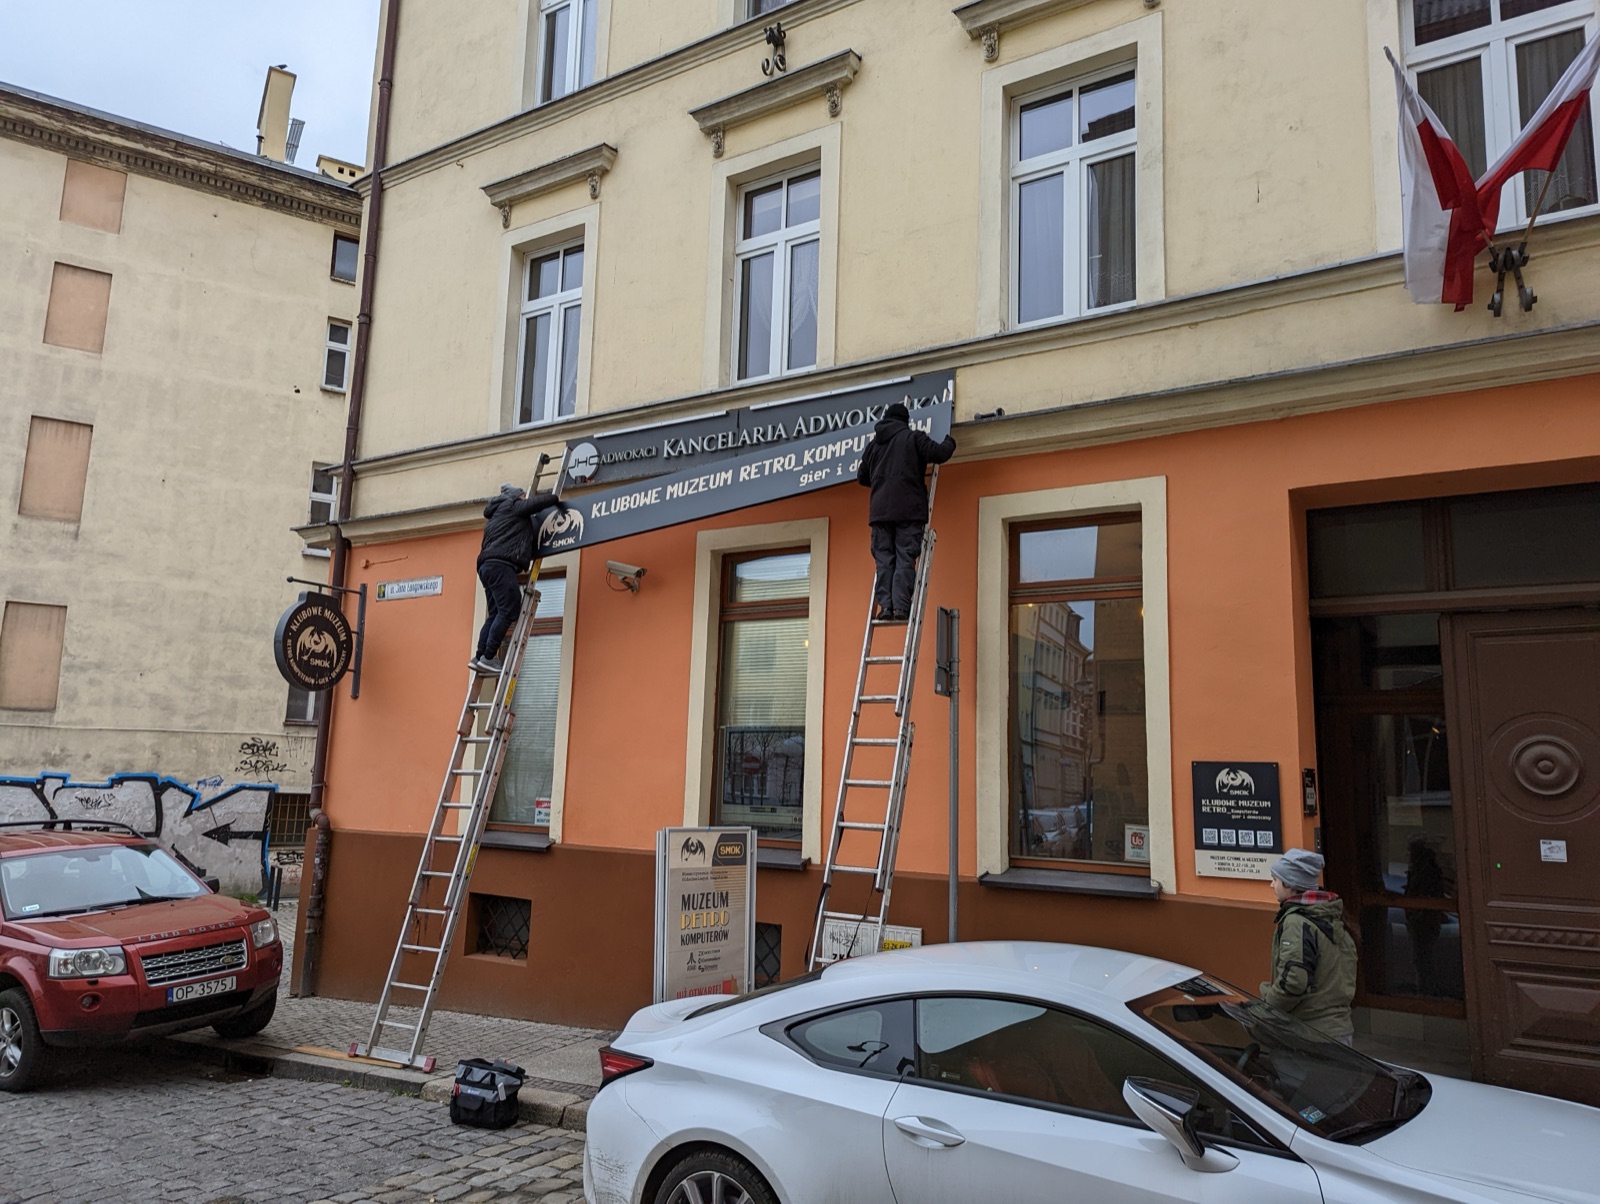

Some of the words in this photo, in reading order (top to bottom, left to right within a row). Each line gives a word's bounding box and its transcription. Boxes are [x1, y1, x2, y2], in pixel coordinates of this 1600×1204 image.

[600, 446, 657, 464] ADWOKACI
[662, 422, 788, 458] KANCELARIA
[799, 468, 831, 487] gier
[836, 463, 843, 476] i
[591, 487, 662, 519] KLUBOWE
[666, 469, 733, 501] MUZEUM
[552, 535, 576, 549] SMOK
[290, 606, 322, 632] KLUBOWE
[324, 608, 347, 642] MUZEUM
[309, 658, 330, 668] SMOK
[1201, 799, 1237, 807] KLUBOWE
[1238, 800, 1271, 808] MUZEUM
[720, 845, 741, 855] SMOK
[681, 891, 729, 912] MUZEUM
[680, 911, 731, 930] RETRO
[138, 930, 180, 941] LAND
[189, 922, 236, 934] ROVER
[680, 927, 729, 947] KOMPUTERÓW
[175, 985, 194, 1000] OP
[198, 977, 234, 996] 3575J
